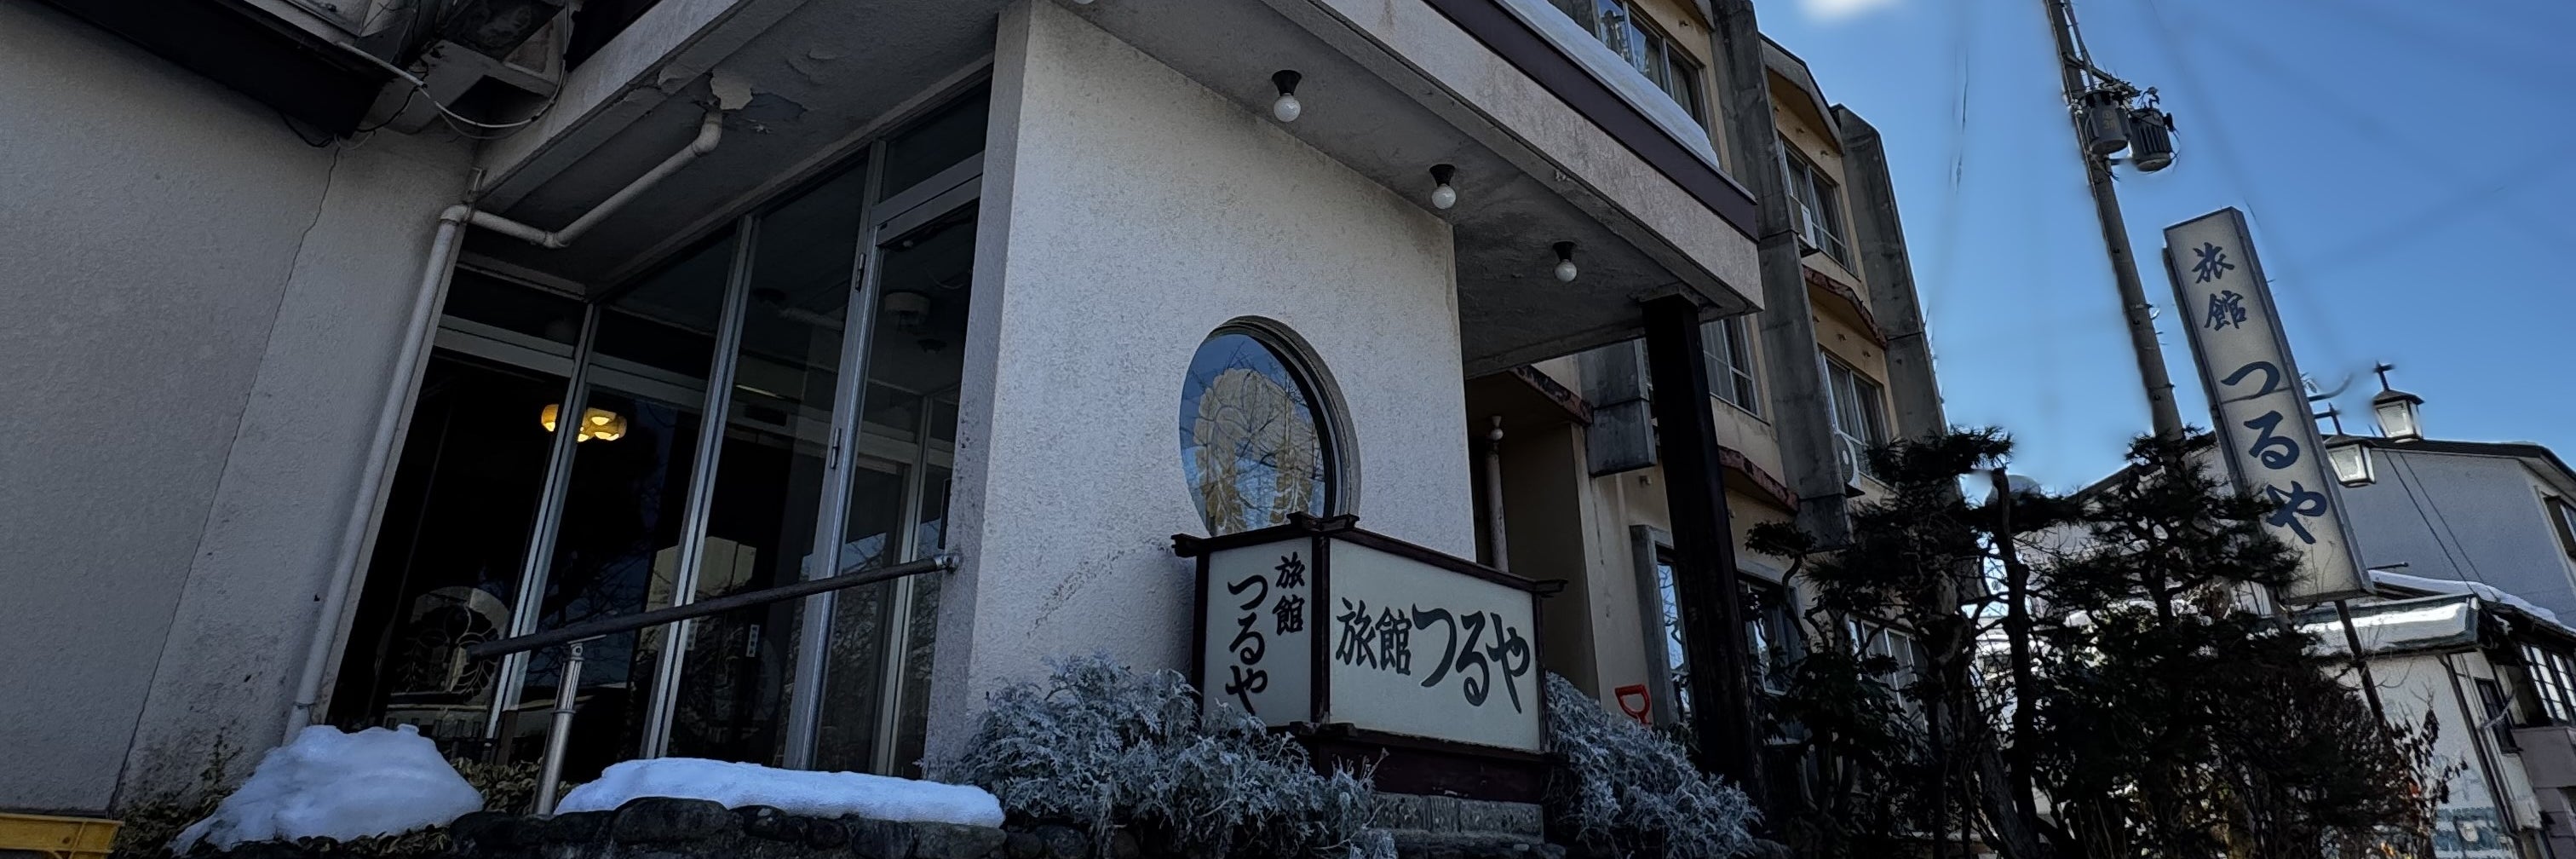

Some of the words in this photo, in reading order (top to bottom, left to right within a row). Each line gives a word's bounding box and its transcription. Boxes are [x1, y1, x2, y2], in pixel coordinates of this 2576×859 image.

[1225, 574, 1268, 716] つるや
[1272, 551, 1306, 636] 旅館
[1335, 597, 1531, 714] 旅館つるや
